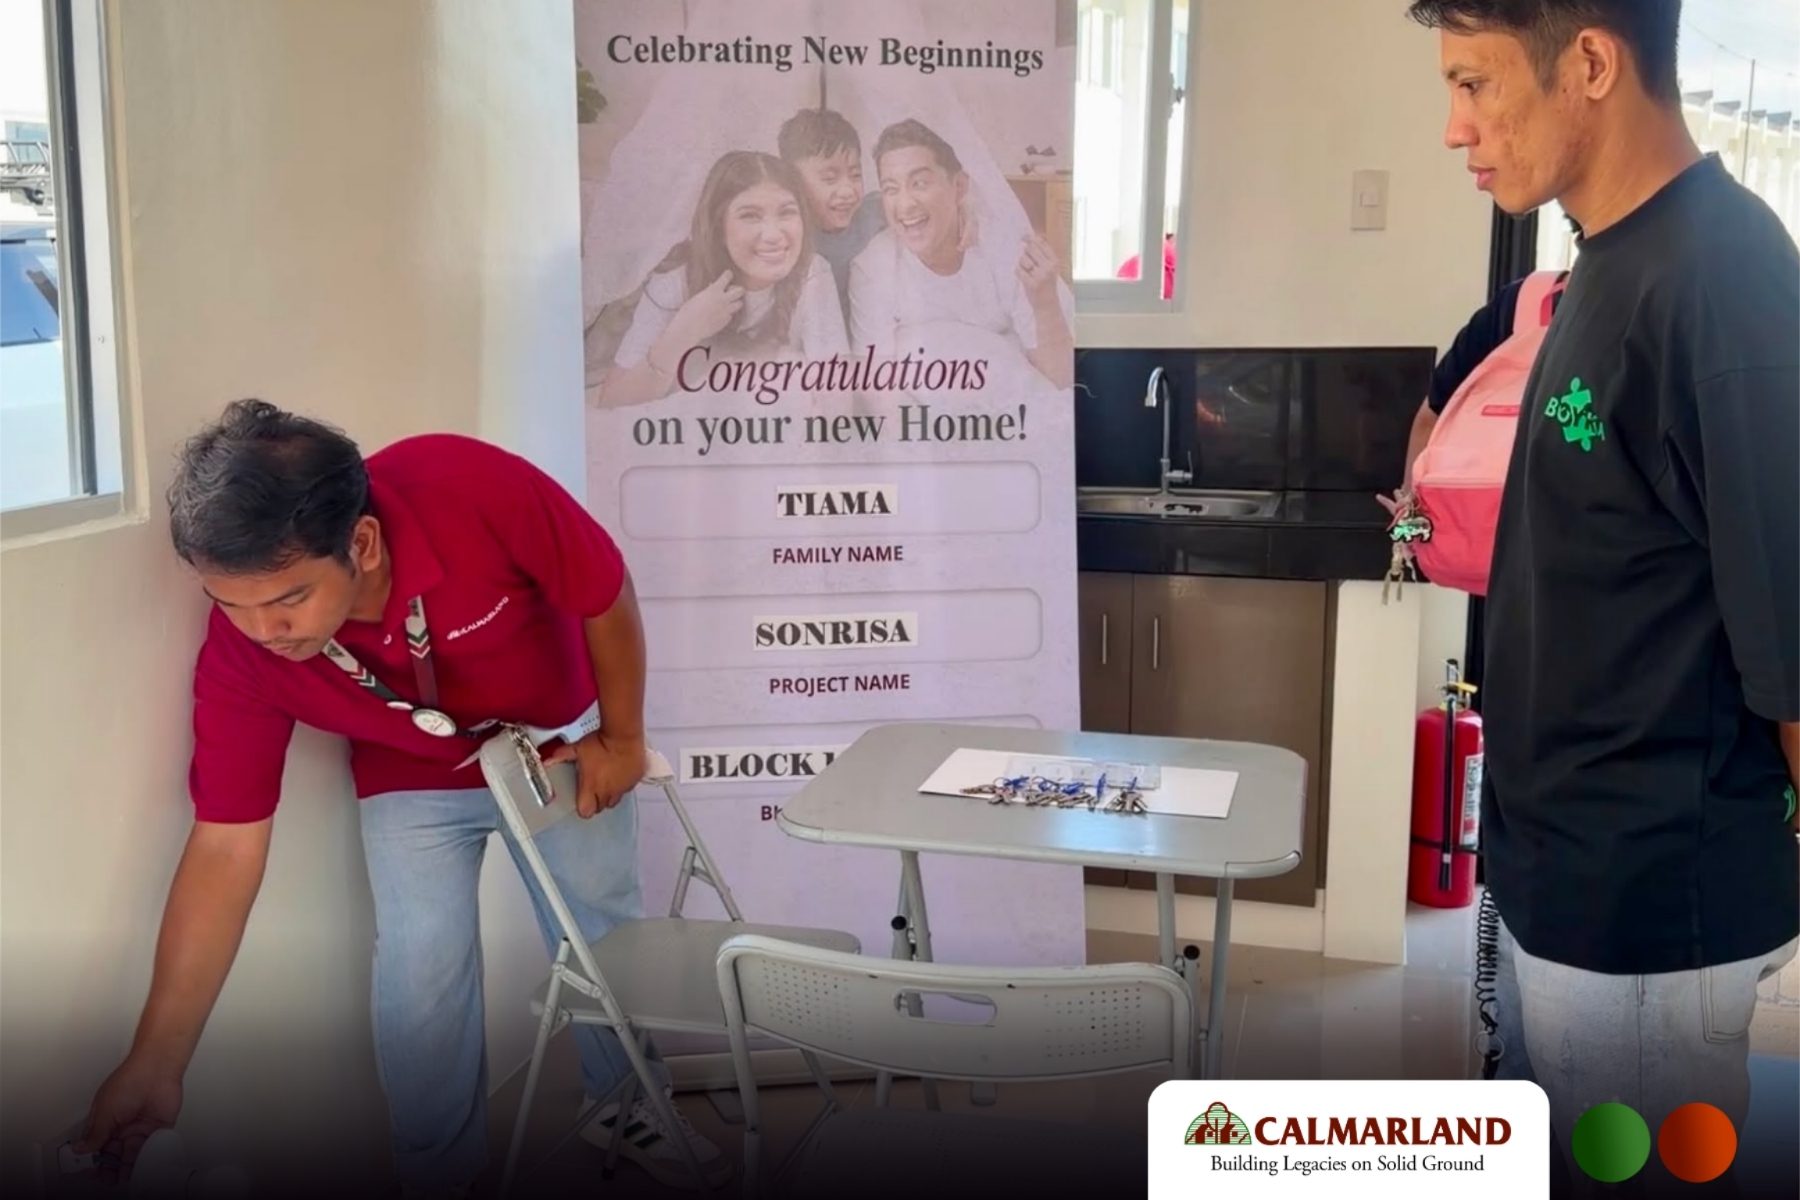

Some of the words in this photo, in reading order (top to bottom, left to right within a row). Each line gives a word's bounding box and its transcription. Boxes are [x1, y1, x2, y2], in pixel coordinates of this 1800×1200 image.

[607, 35, 792, 72] Celebrating
[803, 37, 868, 65] New
[879, 38, 1043, 76] Beginnings
[677, 345, 988, 405] Congratulations
[633, 417, 684, 445] on
[697, 416, 791, 455] your
[805, 416, 886, 443] new
[899, 404, 1027, 442] Home!
[778, 491, 891, 516] TIAMA
[773, 547, 843, 564] FAMILY
[848, 546, 904, 562] NAME
[756, 619, 910, 646] SONRISA
[769, 676, 849, 697] PROJECT
[855, 674, 910, 691] NAME
[690, 753, 816, 778] BLOCK
